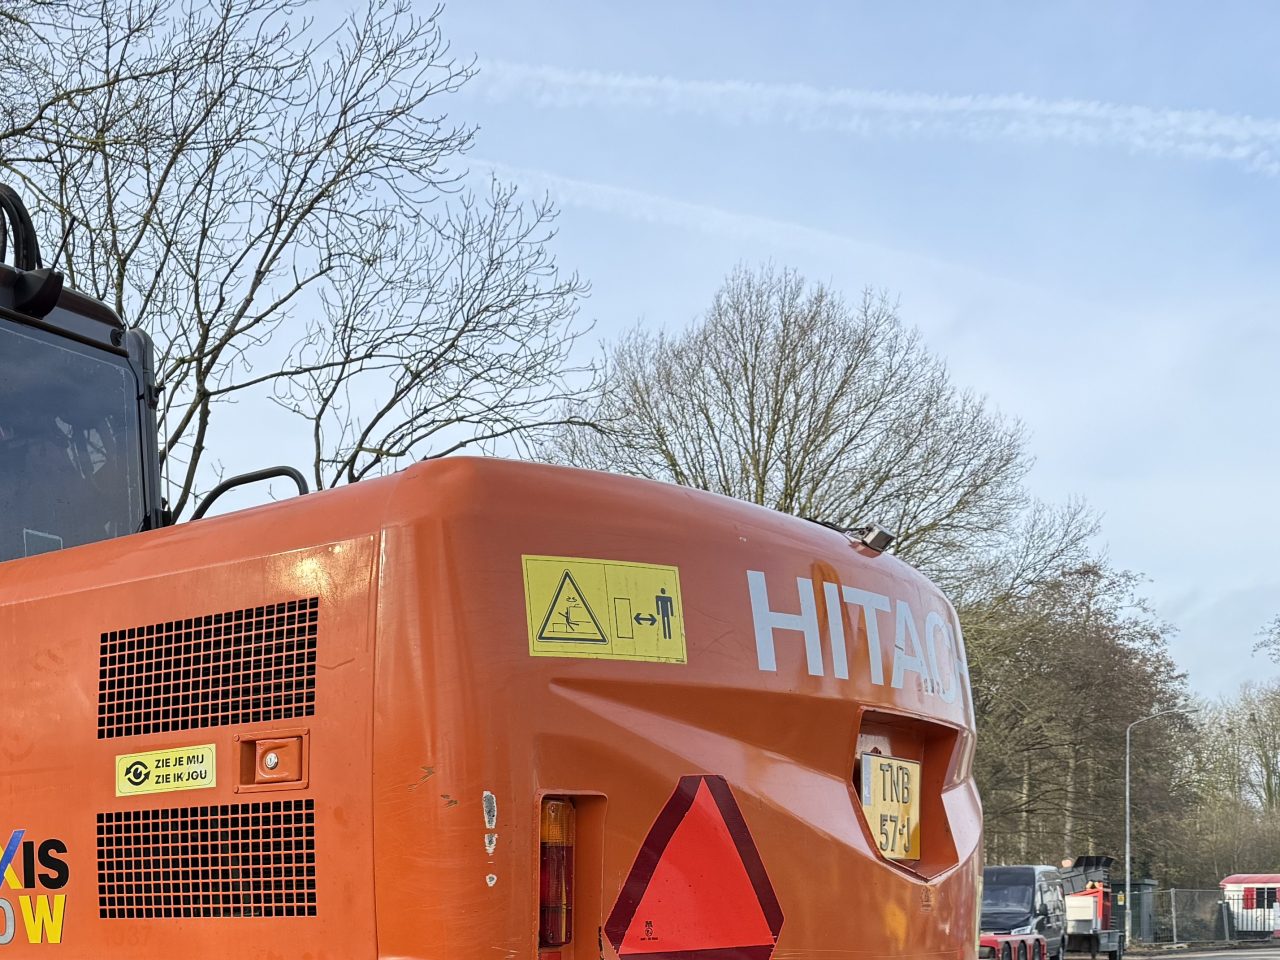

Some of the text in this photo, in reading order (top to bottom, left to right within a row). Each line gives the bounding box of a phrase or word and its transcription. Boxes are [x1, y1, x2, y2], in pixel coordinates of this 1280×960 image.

[154, 754, 204, 769] ZIE JE MIJ
[154, 769, 207, 784] ZIE IK JOU
[879, 762, 911, 804] TNB
